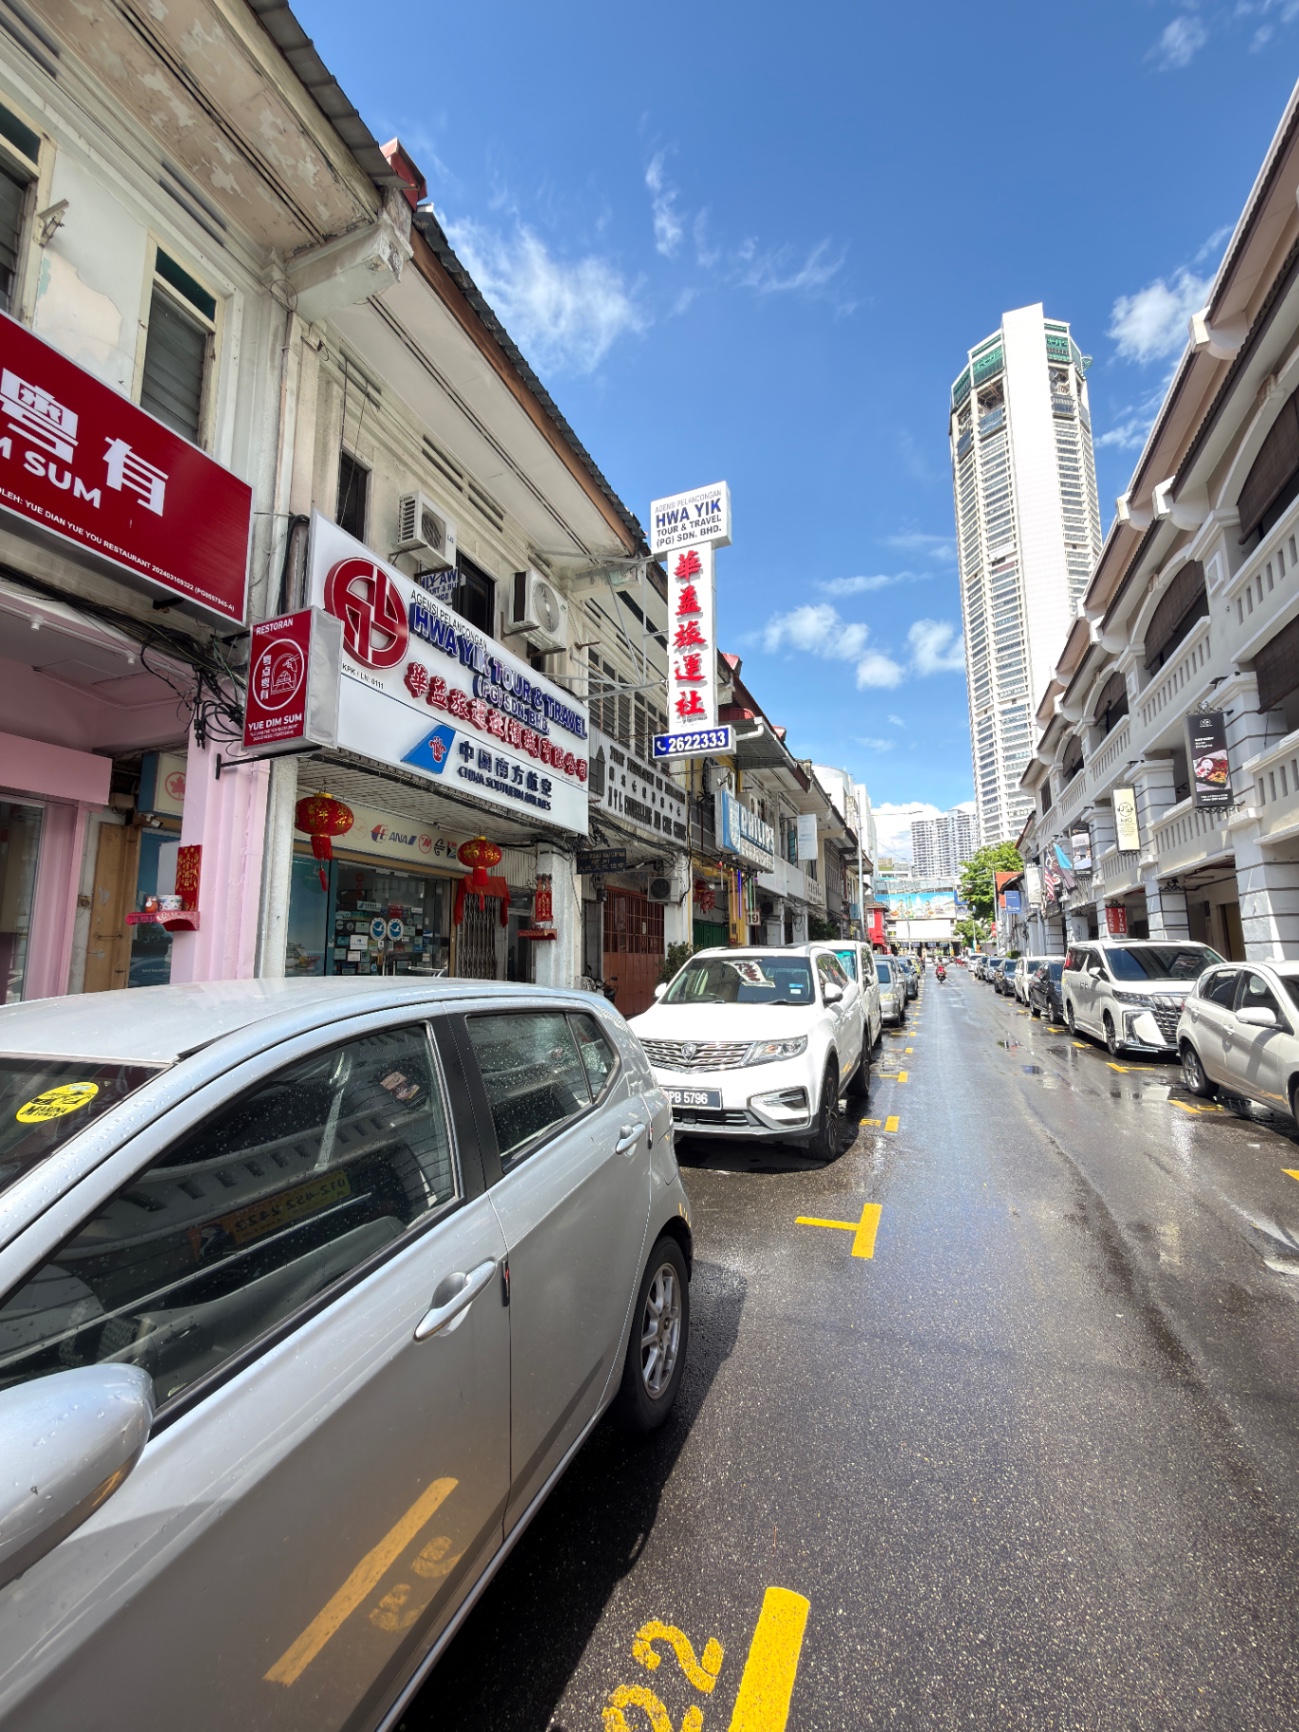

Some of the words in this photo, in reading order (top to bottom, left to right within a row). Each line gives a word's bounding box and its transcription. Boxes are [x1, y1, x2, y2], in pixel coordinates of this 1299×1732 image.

[23, 450, 102, 509] SUM
[655, 507, 690, 529] HWA
[694, 497, 722, 519] YIK
[656, 525, 678, 538] TOUR
[680, 522, 687, 532] &
[689, 514, 722, 529] TRAVEL
[0, 487, 23, 504] LEH:
[25, 500, 44, 515] YUE
[44, 510, 66, 526] DIAN
[67, 521, 85, 536] YUE
[85, 530, 103, 544] YOU
[103, 540, 151, 568] RESTAURANT
[656, 537, 675, 547] (PG)
[677, 531, 698, 542] SDN.
[700, 525, 721, 536] BHD.
[411, 589, 439, 617] AGENSI
[256, 617, 294, 636] RESTORAN
[411, 603, 458, 657] HWA
[457, 635, 491, 677] YIK
[490, 657, 534, 706] TOUR
[531, 686, 544, 713] &
[541, 693, 588, 740] TRAVEL
[473, 674, 504, 708] (PG)
[248, 720, 265, 731] YUE
[265, 717, 282, 728] DIM
[283, 712, 302, 724] SUM
[668, 731, 726, 752] 2622333
[457, 766, 485, 786] CHINA
[485, 777, 523, 802] SOUTHERN
[522, 790, 552, 811] AIRLINES
[389, 831, 409, 845] ANA
[683, 1091, 708, 1105] 5796
